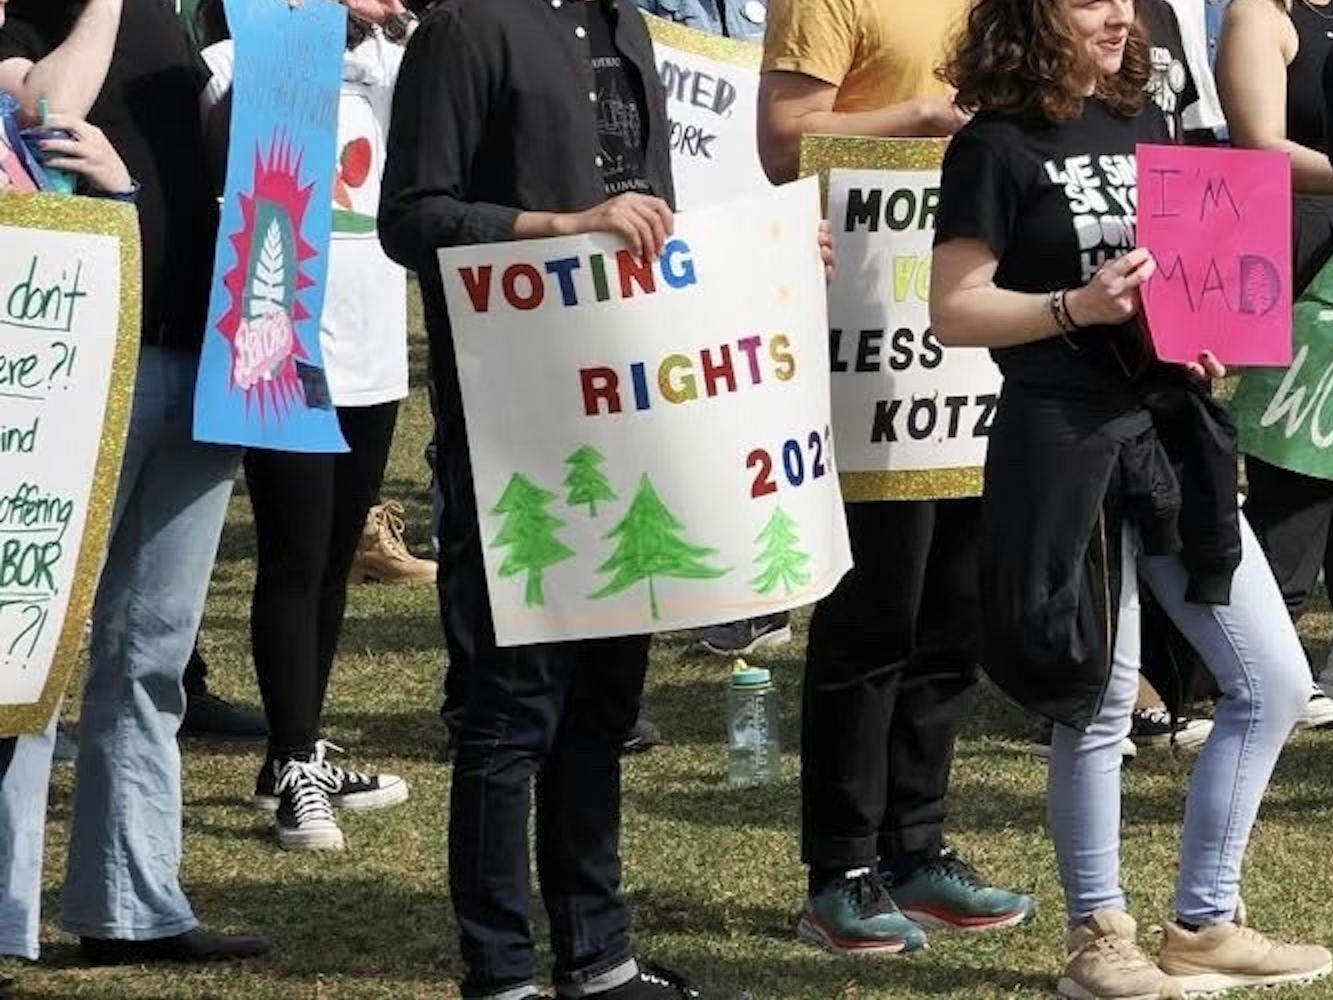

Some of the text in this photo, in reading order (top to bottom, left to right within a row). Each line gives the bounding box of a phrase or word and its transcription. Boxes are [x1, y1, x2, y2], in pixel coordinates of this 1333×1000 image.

[661, 59, 737, 119] OYED,
[669, 118, 718, 159] ORK
[844, 187, 942, 233] MOR
[1150, 167, 1241, 222] I'M
[8, 255, 87, 332] don't
[458, 238, 697, 313] VOTING
[1148, 250, 1282, 316] MAD
[579, 333, 797, 417] RIGHTS
[829, 327, 943, 373] LESS
[0, 417, 39, 453] ind
[870, 393, 999, 444] KOTZ
[744, 423, 832, 500] 202
[0, 539, 62, 596] BOR,
